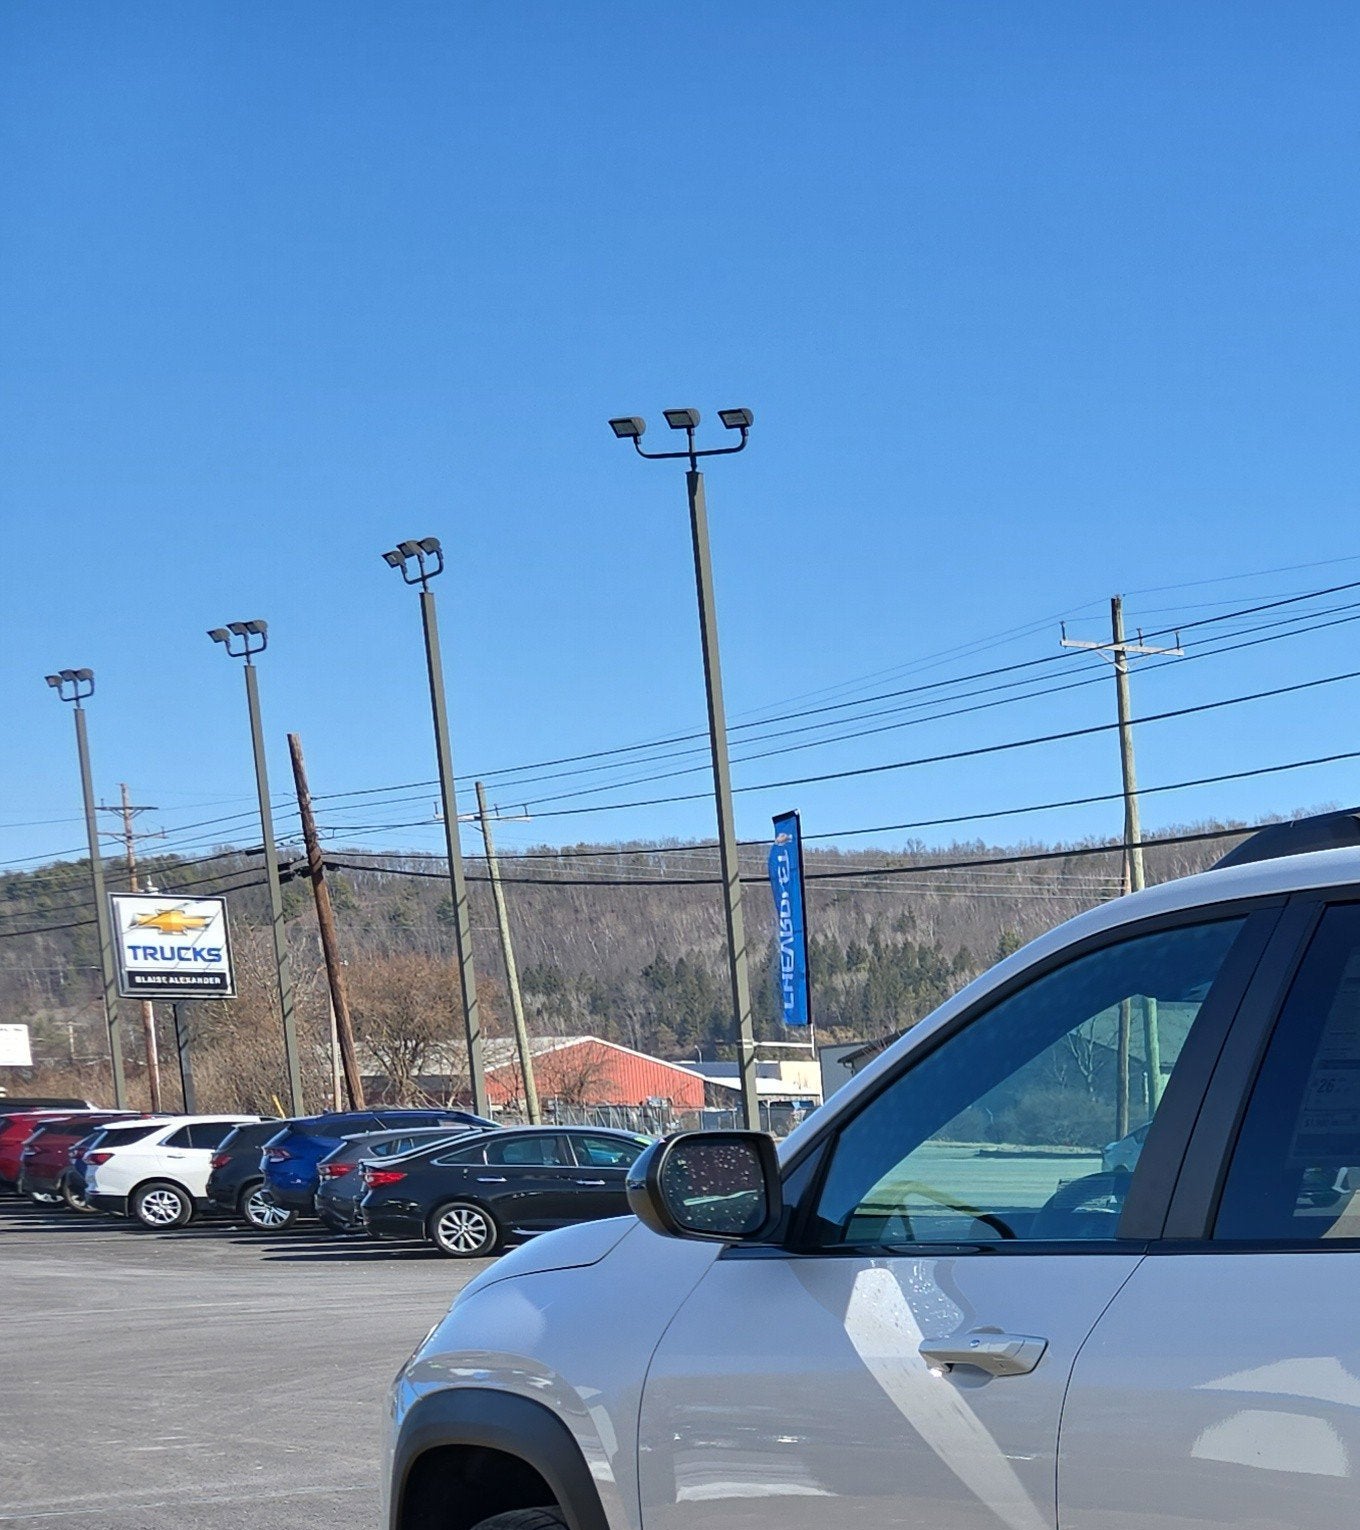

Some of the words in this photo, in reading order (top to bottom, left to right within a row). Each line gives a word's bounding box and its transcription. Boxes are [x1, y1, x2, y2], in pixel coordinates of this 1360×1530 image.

[127, 945, 222, 963] TRUCKS
[134, 975, 168, 985] BLAISE
[168, 975, 221, 985] ALEXANDER
